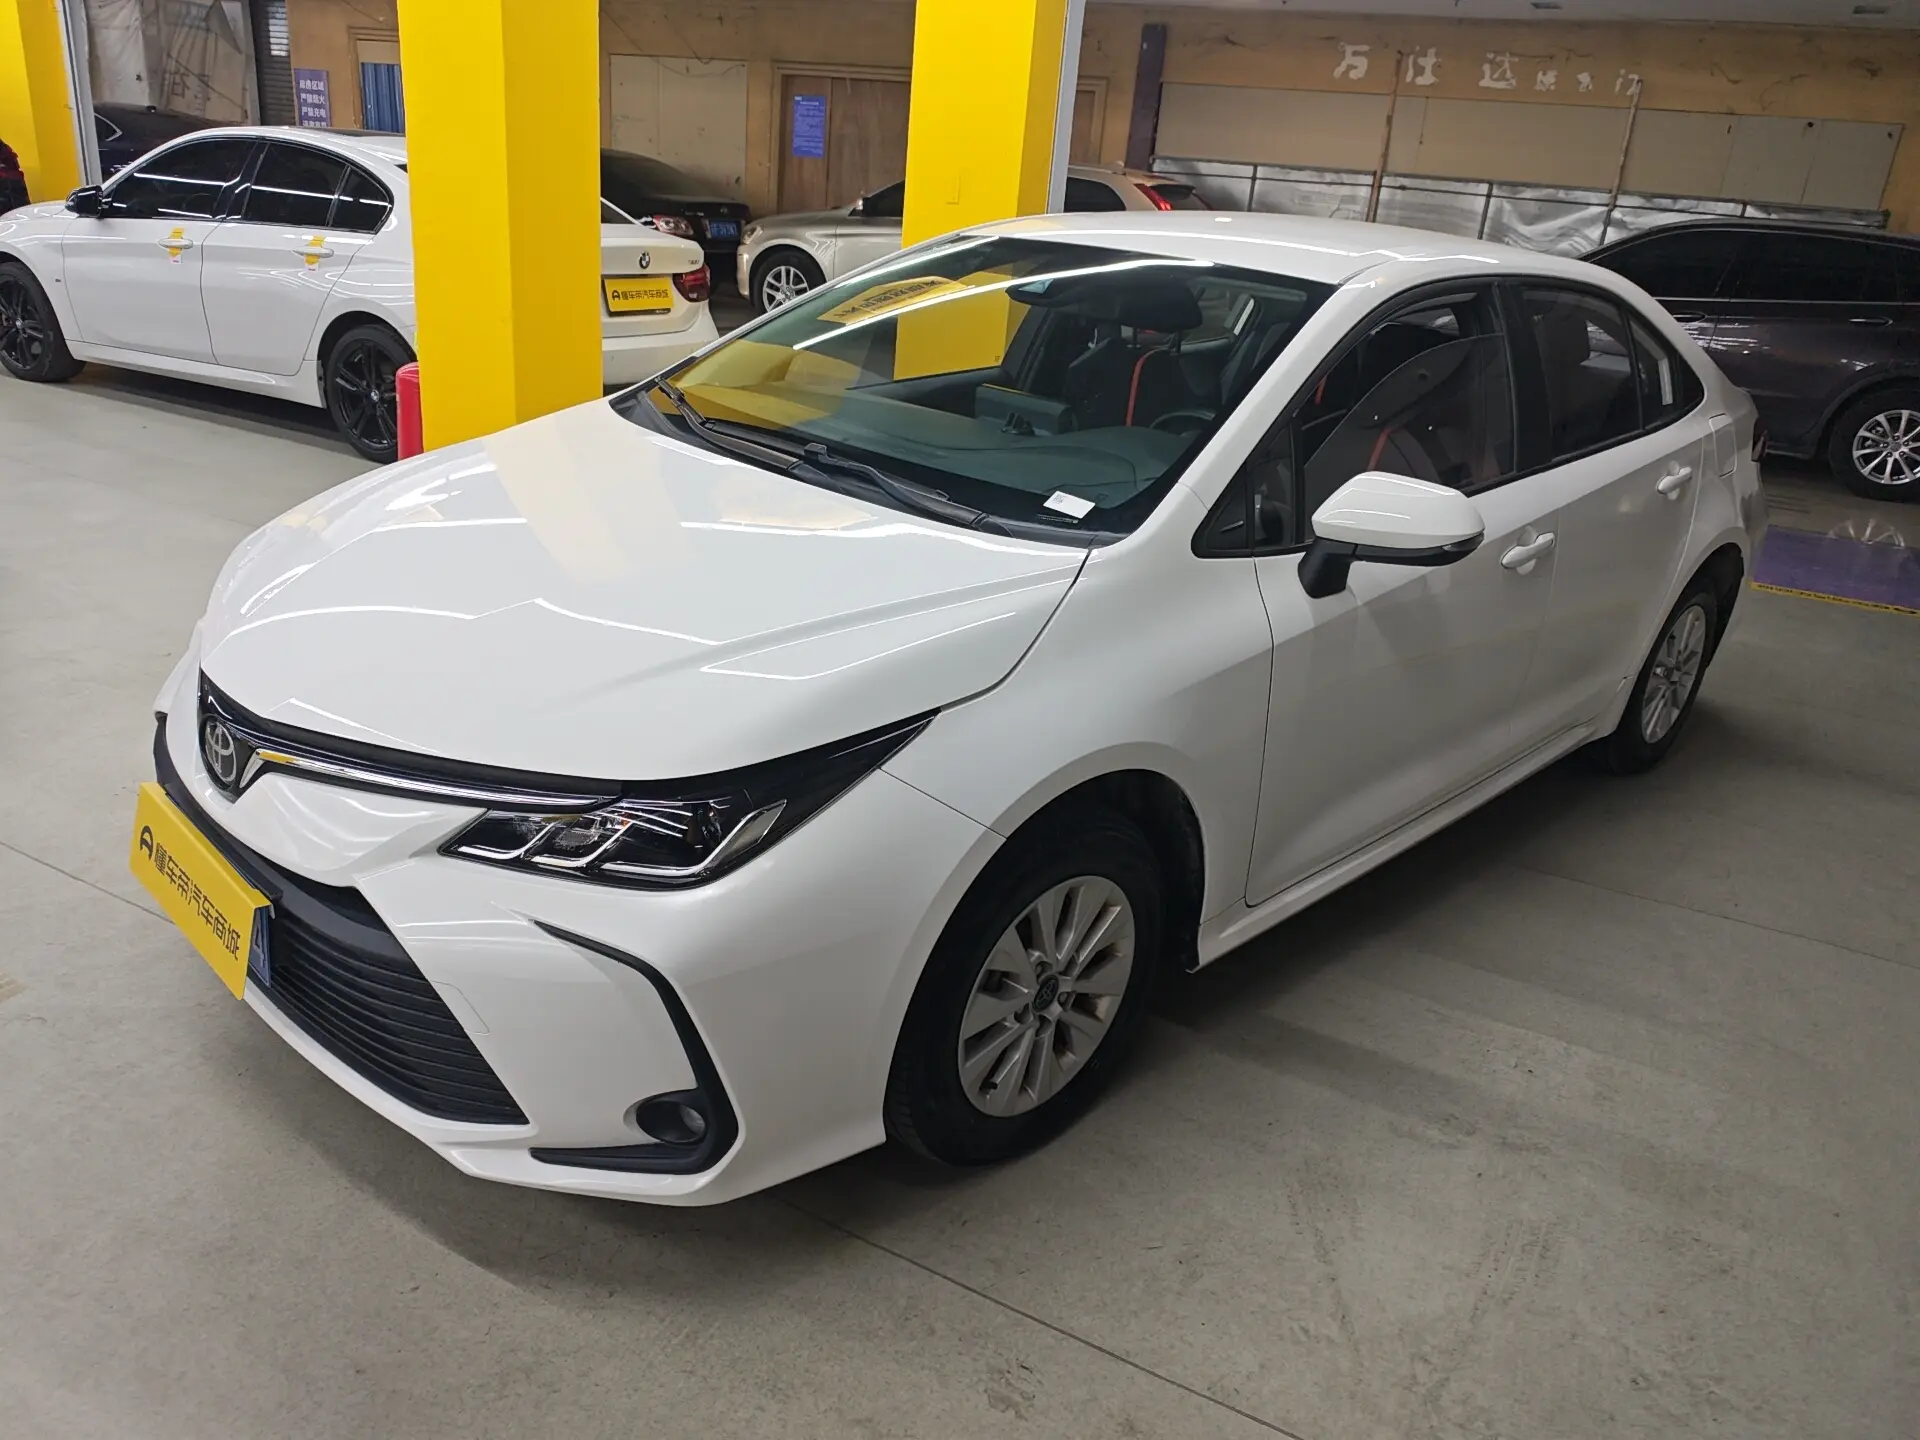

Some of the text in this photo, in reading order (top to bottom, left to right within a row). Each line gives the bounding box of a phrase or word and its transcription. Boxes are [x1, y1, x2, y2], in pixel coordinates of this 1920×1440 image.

[154, 841, 241, 961] 懂车帝汽车商城
